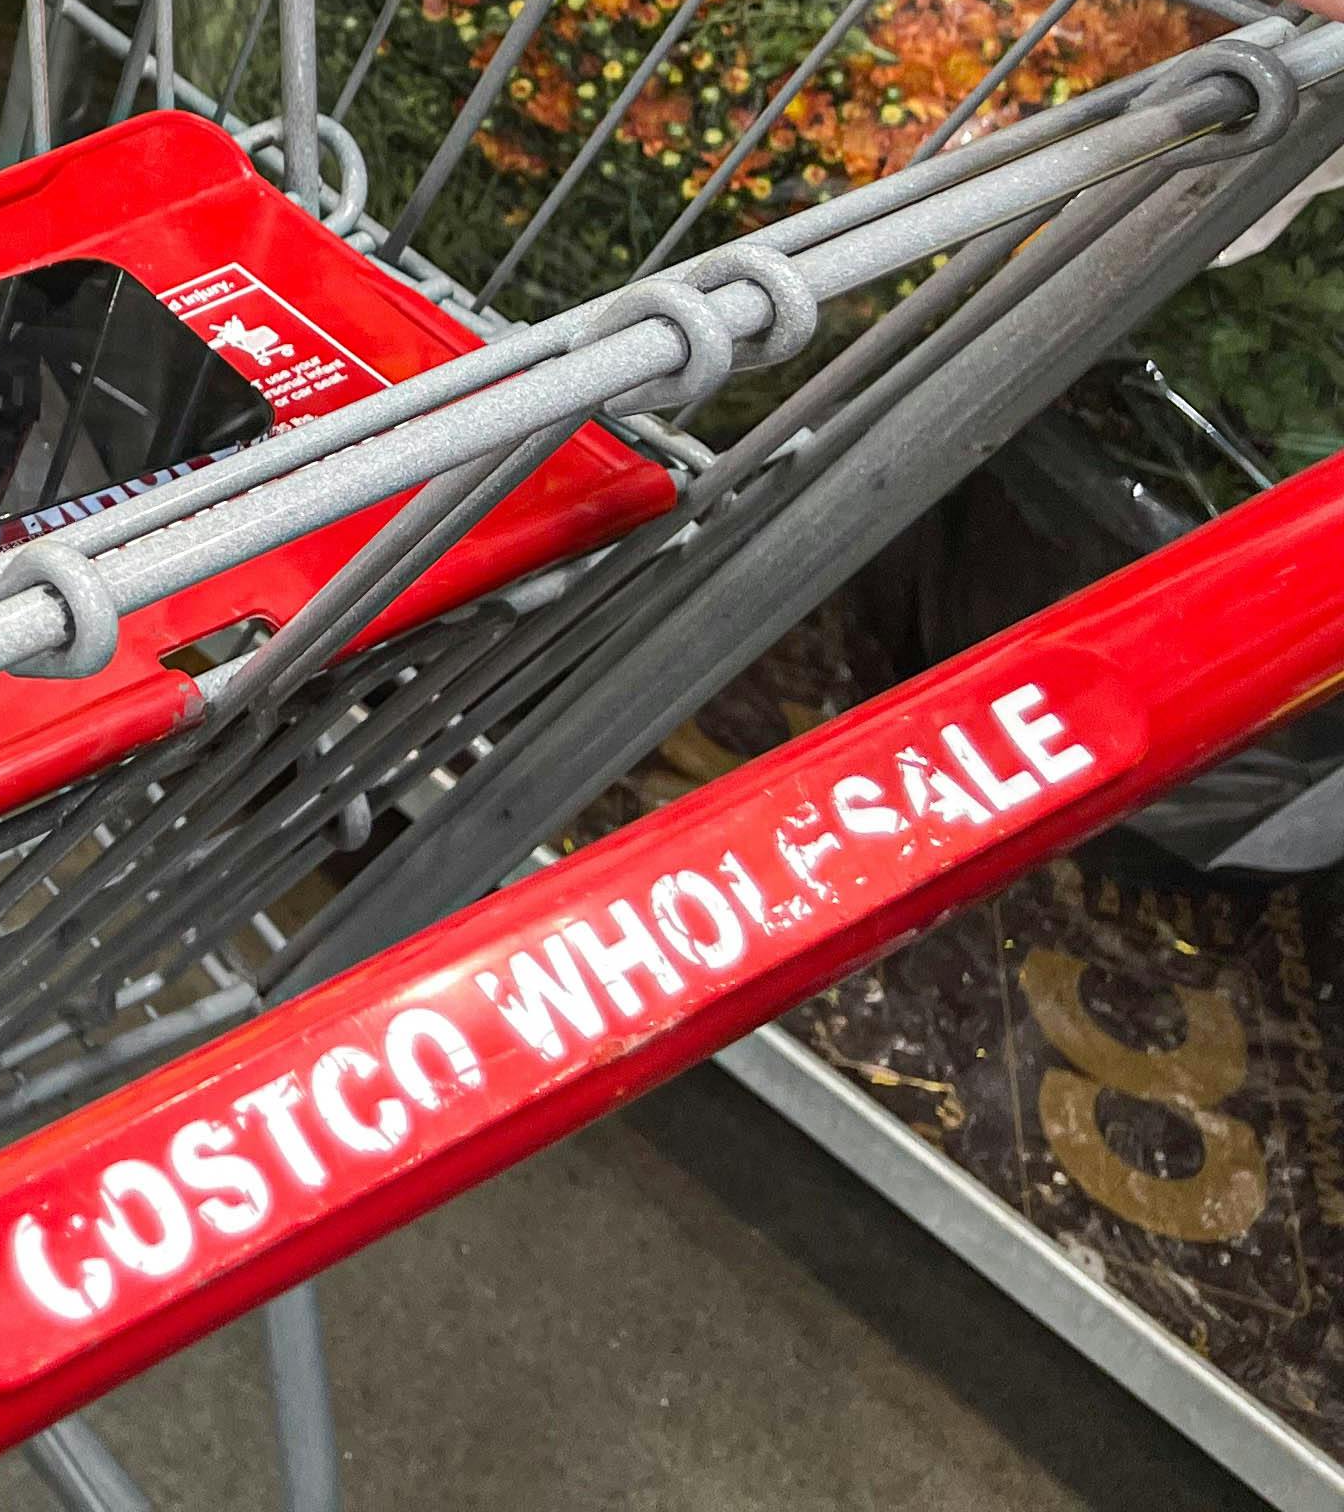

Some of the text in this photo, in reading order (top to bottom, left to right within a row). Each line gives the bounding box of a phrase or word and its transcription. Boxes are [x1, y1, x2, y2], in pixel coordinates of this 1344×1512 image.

[179, 279, 235, 307] injury.
[264, 369, 292, 385] use
[289, 355, 322, 376] your
[13, 1007, 486, 1320] COSTCO
